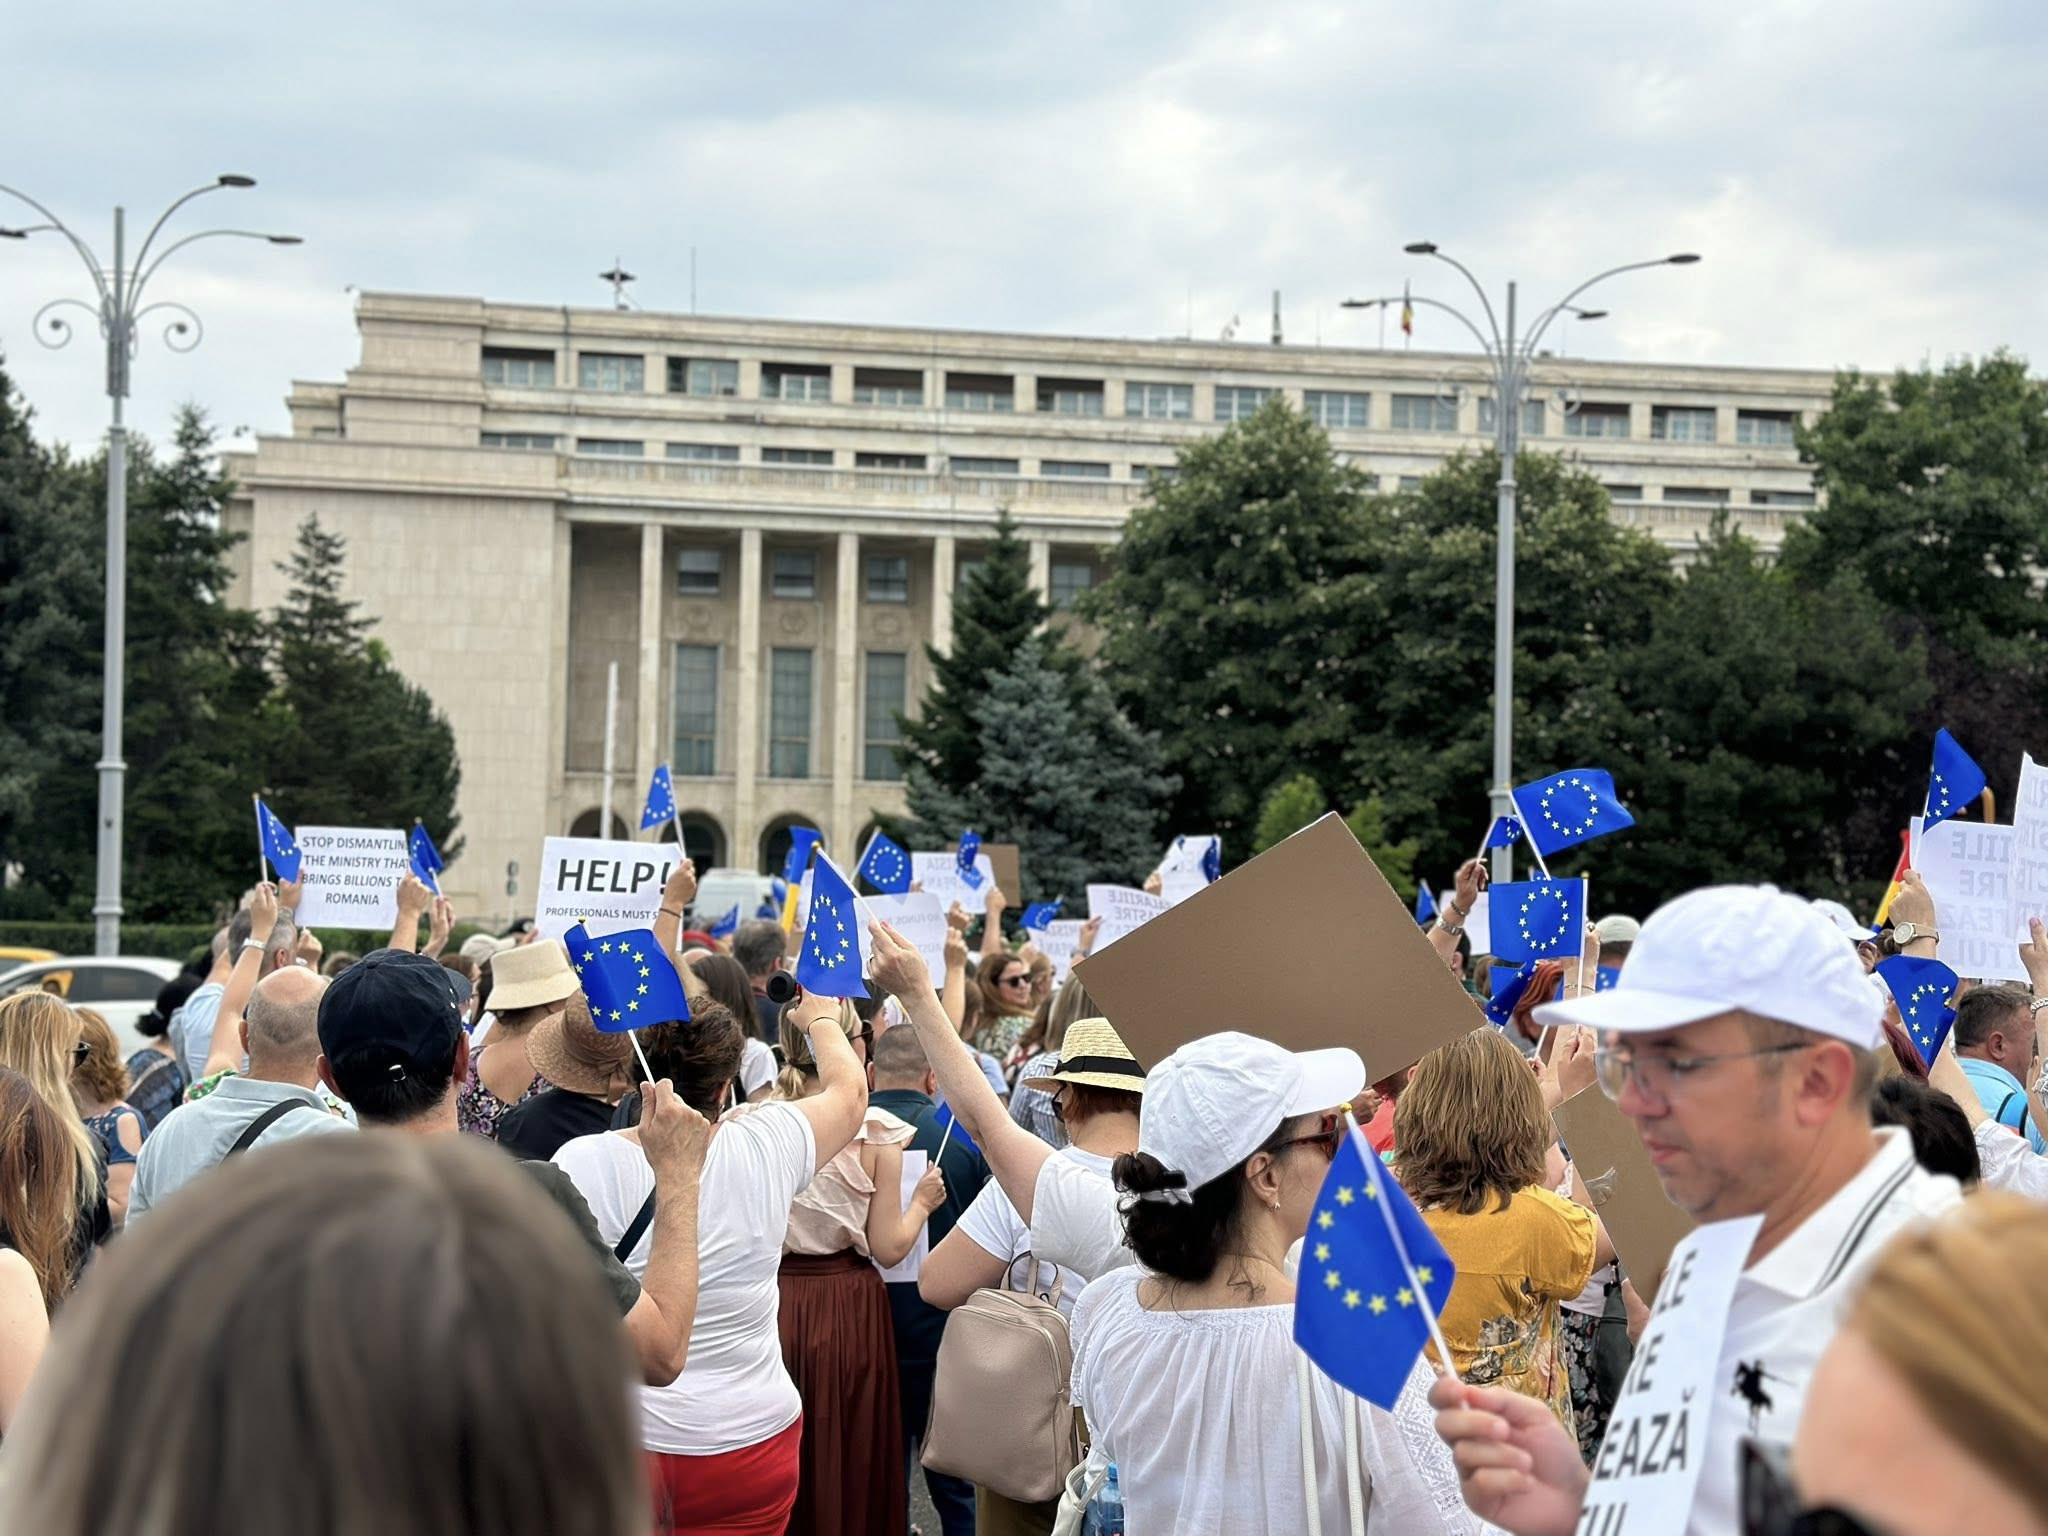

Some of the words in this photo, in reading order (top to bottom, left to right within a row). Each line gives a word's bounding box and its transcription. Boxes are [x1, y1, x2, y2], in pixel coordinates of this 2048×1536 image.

[302, 836, 335, 848] STOP
[336, 837, 407, 851] DISMANTLIN
[303, 854, 326, 867] THE
[328, 855, 382, 869] MINISTRY
[301, 872, 342, 886] BRINGS
[343, 873, 393, 888] BILLIONS
[395, 876, 403, 888] T
[556, 857, 671, 896] HELP!
[324, 892, 380, 906] ROMANIA
[545, 906, 620, 919] PROFESSIONALS
[621, 909, 651, 920] MUST
[1594, 1385, 1697, 1481] EAZĂ
